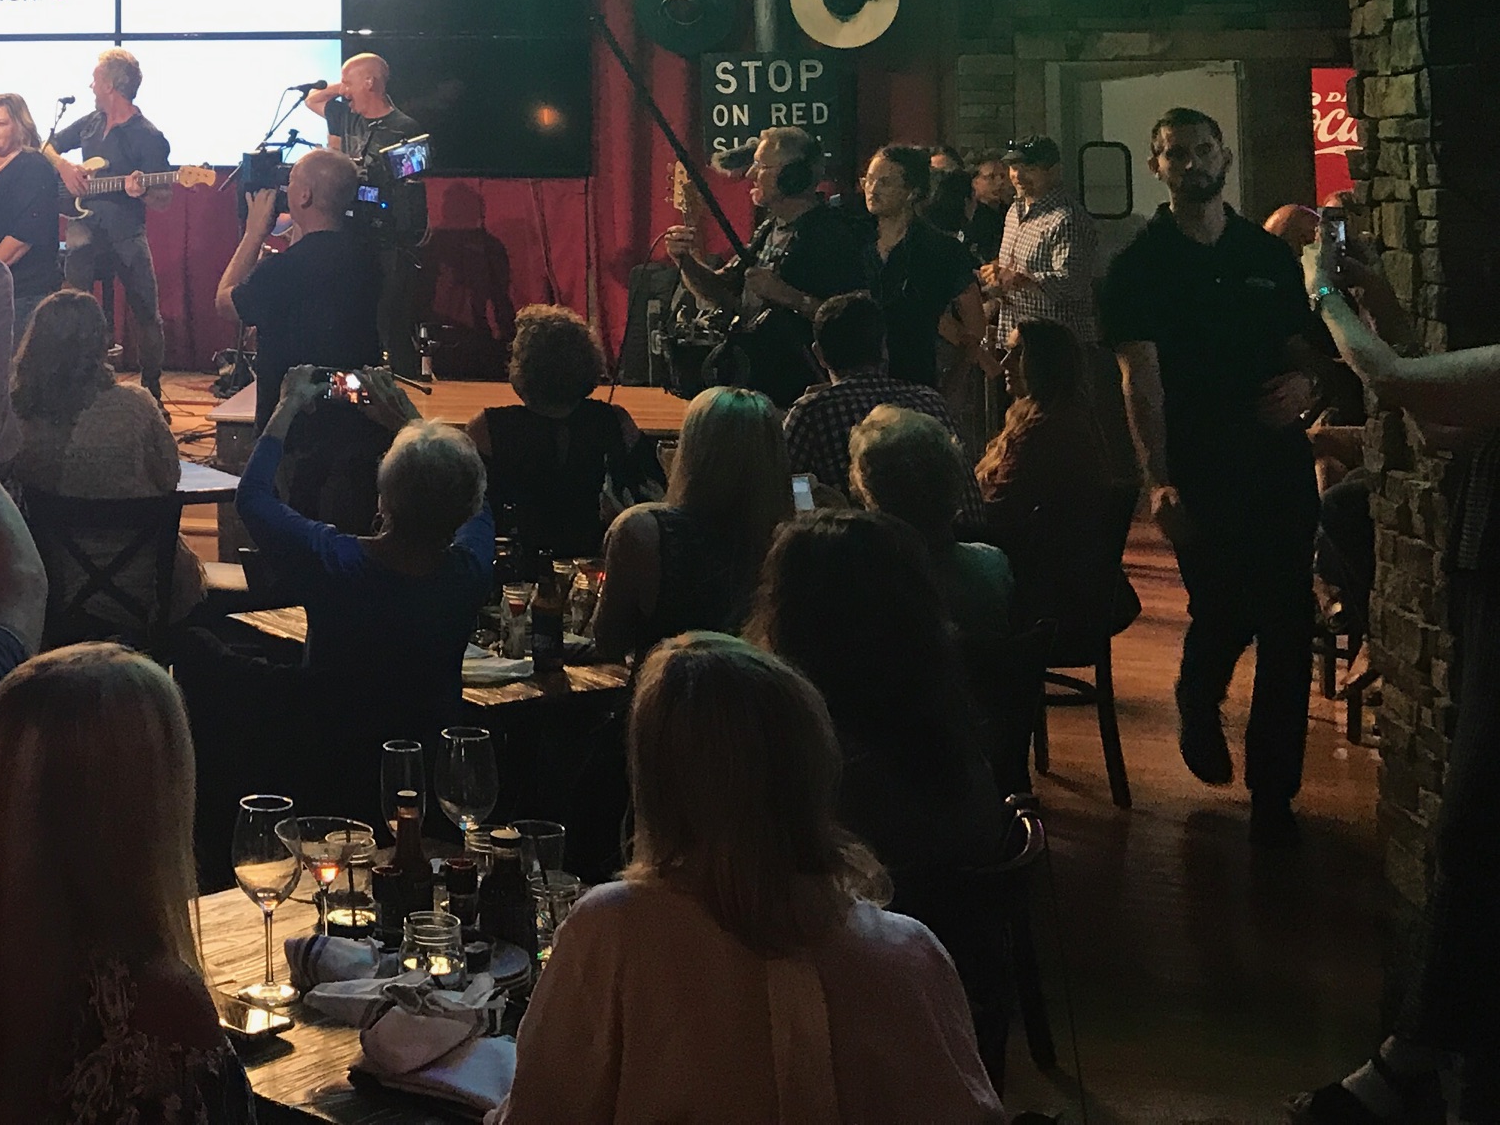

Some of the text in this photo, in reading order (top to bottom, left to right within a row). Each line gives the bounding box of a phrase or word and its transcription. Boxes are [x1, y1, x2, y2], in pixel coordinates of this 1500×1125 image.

[714, 58, 824, 95] STOP
[712, 102, 829, 127] ON RED
